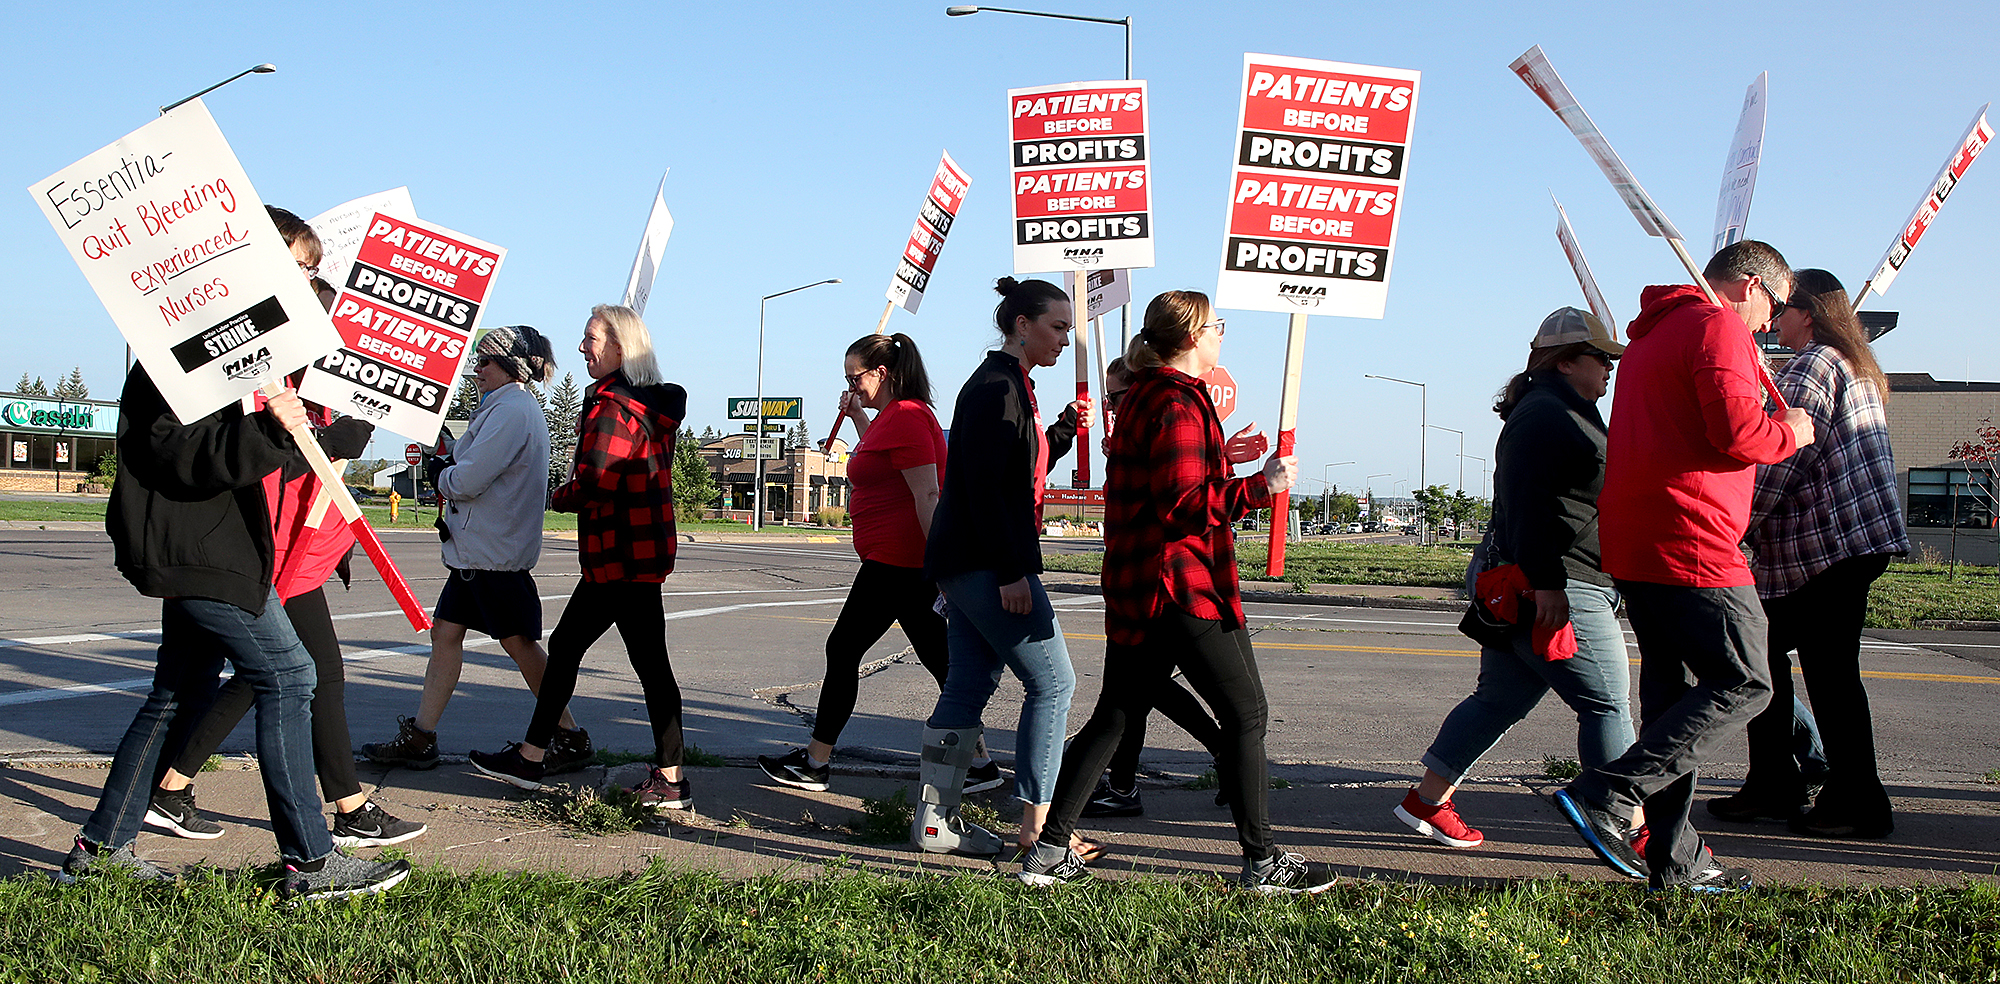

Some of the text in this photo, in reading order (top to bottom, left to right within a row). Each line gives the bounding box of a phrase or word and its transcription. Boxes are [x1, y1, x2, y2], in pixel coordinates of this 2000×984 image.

[1014, 92, 1142, 118] PATIENTS
[1249, 71, 1412, 112] PATIENTS
[1044, 118, 1113, 134] BEFORE
[1283, 108, 1369, 134] BEFORE
[1021, 139, 1137, 164] PROFITS
[1250, 136, 1394, 175] PROFITS
[47, 152, 173, 229] Essentia-
[1017, 170, 1145, 195] PATIENTS
[1236, 179, 1396, 216] PATIENTS
[82, 177, 237, 261] Quit Bleeding
[1047, 195, 1116, 212] BEFORE
[1025, 216, 1141, 242] PROFITS
[1269, 215, 1354, 237] BEFORE
[131, 223, 249, 295] experienced
[367, 219, 498, 277] PATIENTS
[1065, 247, 1104, 256] MNA
[1236, 242, 1377, 277] PROFITS
[390, 254, 459, 288] BEFORE
[1087, 276, 1103, 292] RIKE
[158, 276, 230, 327] Nurses
[354, 267, 471, 326] PROFITS
[1280, 283, 1327, 296] MNA
[204, 318, 260, 358] STRIKE
[334, 299, 465, 359] PATIENTS
[226, 346, 271, 377] MNA
[357, 333, 427, 370] BEFORE
[322, 348, 439, 408] PROFITS
[352, 391, 392, 413] MNA
[1206, 383, 1234, 407] OP
[11, 401, 95, 428] Wasabi
[723, 449, 742, 459] SUB
